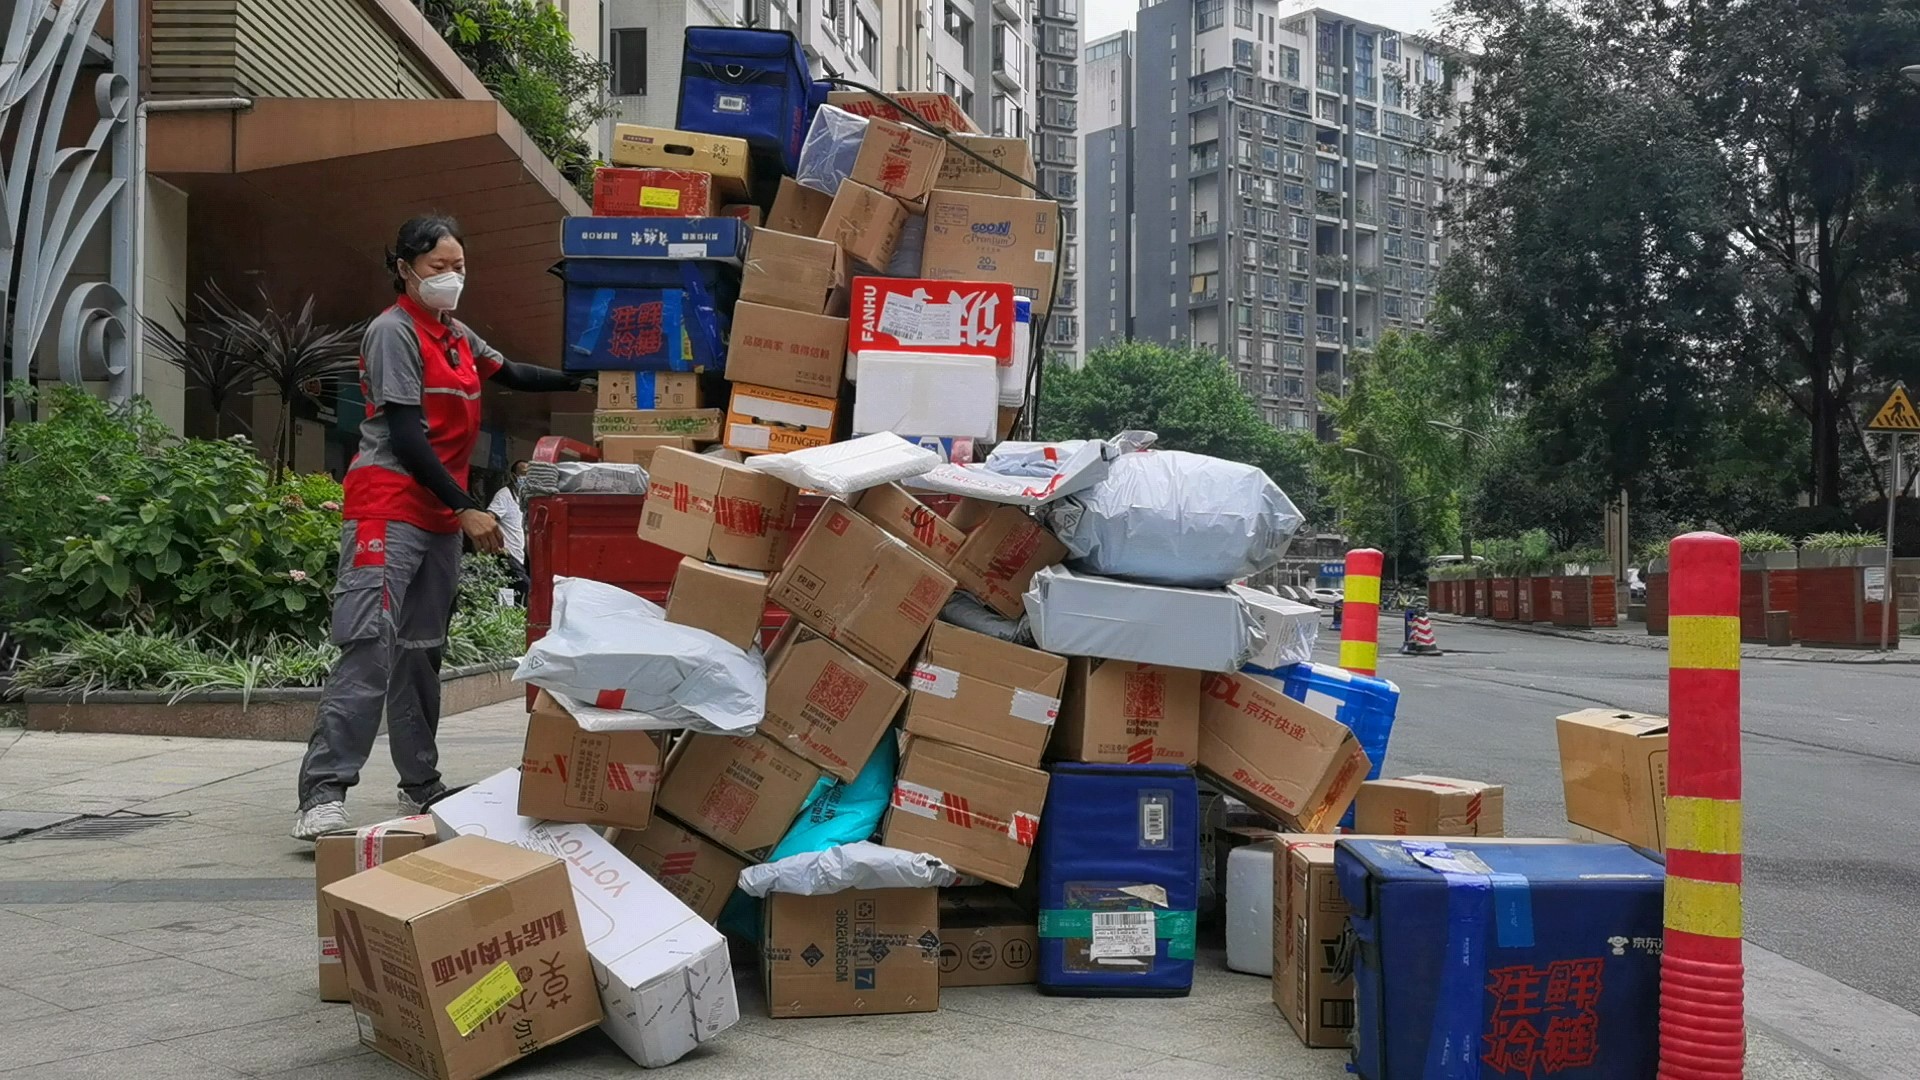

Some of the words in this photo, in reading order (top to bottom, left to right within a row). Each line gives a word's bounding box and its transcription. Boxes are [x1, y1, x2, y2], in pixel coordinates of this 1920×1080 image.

[608, 327, 663, 359] 冷链
[613, 302, 663, 330] 生鲜
[861, 285, 878, 342] FANHU
[1242, 702, 1309, 742] 京东快递
[430, 909, 569, 987] 私房牛肉小面
[836, 908, 848, 983] 36X20X26CM
[1486, 957, 1604, 1018] 生鲜
[1482, 1012, 1599, 1079] 冷链
